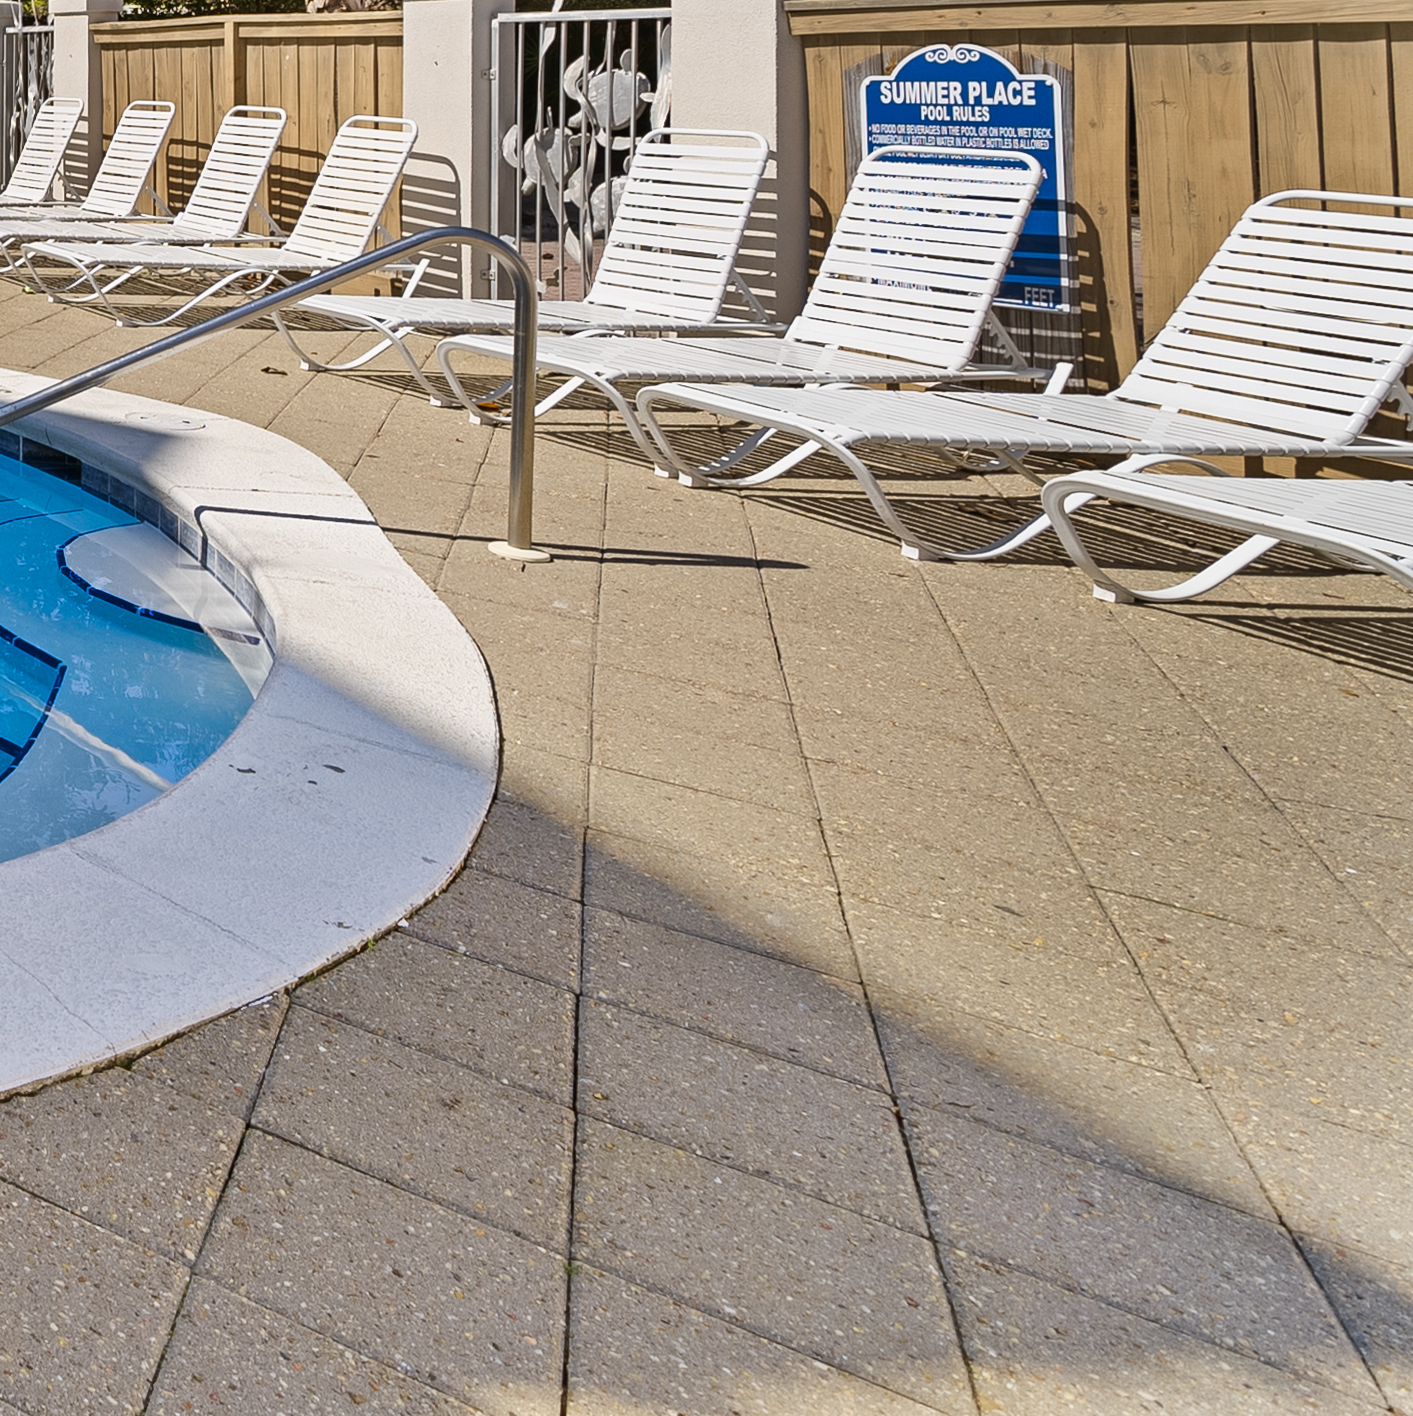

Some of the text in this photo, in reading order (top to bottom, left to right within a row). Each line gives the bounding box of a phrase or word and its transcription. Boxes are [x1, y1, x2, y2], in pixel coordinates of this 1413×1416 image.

[879, 81, 1036, 105] SUMMER PLACE
[920, 105, 990, 122] POOL RULES
[871, 123, 880, 133] NO
[881, 124, 896, 134] FOOD
[897, 124, 906, 134] OR
[906, 124, 940, 135] BEVERAGES
[941, 125, 948, 135] IN
[948, 125, 960, 136] THE
[961, 126, 978, 136] POOL
[978, 126, 988, 136] OR
[989, 127, 999, 137] ON
[999, 127, 1017, 137] POOL
[1017, 127, 1032, 138] WET
[872, 134, 1049, 150] COMMERCIALLY BOTTLED WATER IN PLASTIC BOTTLES IS ALLOWED
[1024, 287, 1055, 307] FEET
